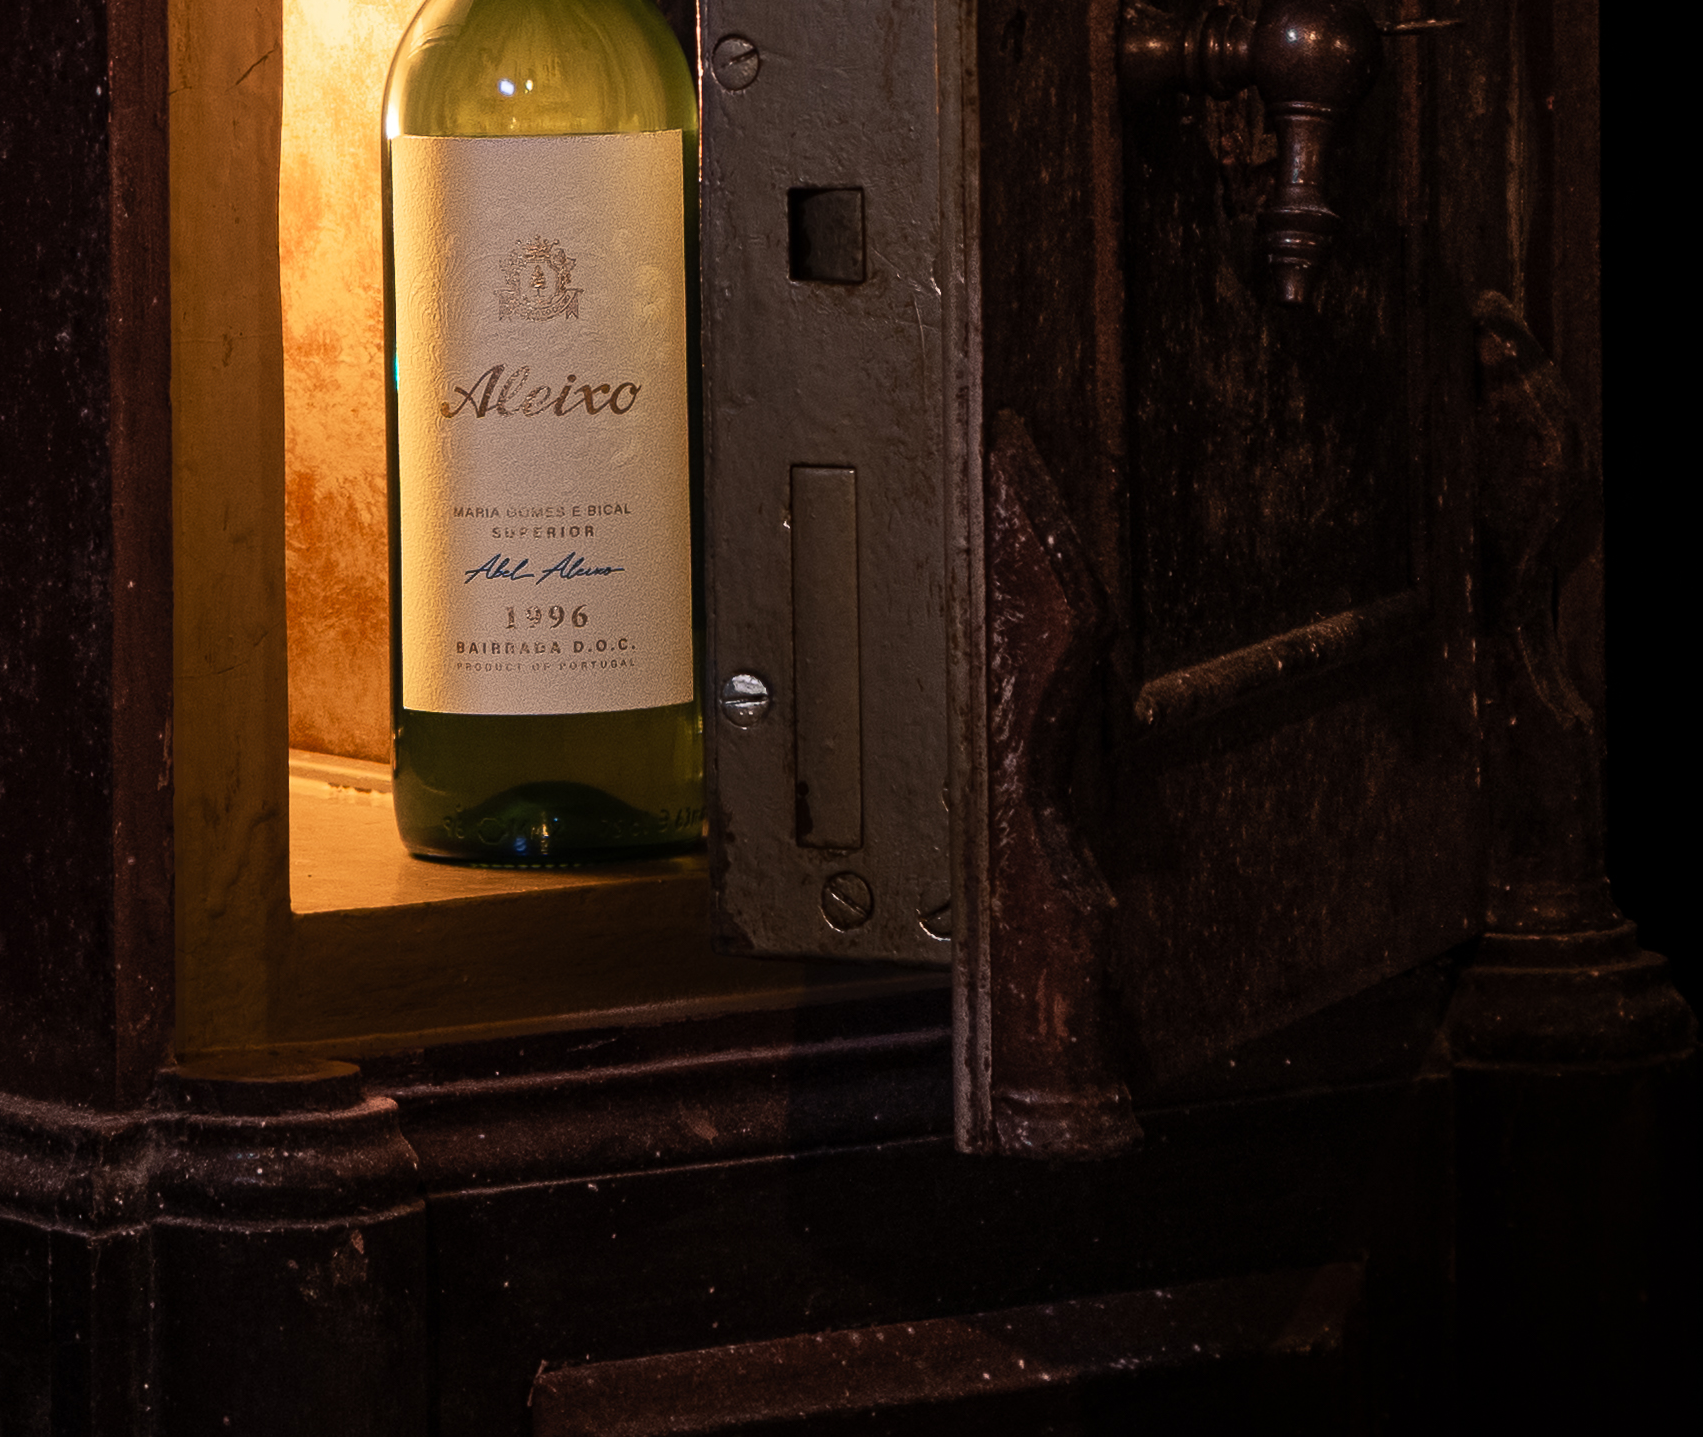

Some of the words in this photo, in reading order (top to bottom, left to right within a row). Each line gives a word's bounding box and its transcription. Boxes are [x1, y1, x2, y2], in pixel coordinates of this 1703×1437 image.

[440, 363, 642, 419] Aleixo
[453, 506, 500, 519] MARIA
[506, 506, 565, 518] GOMES
[572, 505, 581, 517] E
[587, 503, 632, 516] BICAL
[491, 525, 595, 539] SUPERIOR
[505, 604, 589, 630] 1996
[456, 641, 562, 655] BAIRRADA
[573, 638, 636, 653] D.O.C.
[456, 661, 523, 672] PRODUCT
[532, 662, 551, 671] OF
[559, 659, 636, 670] PORTUGAL
